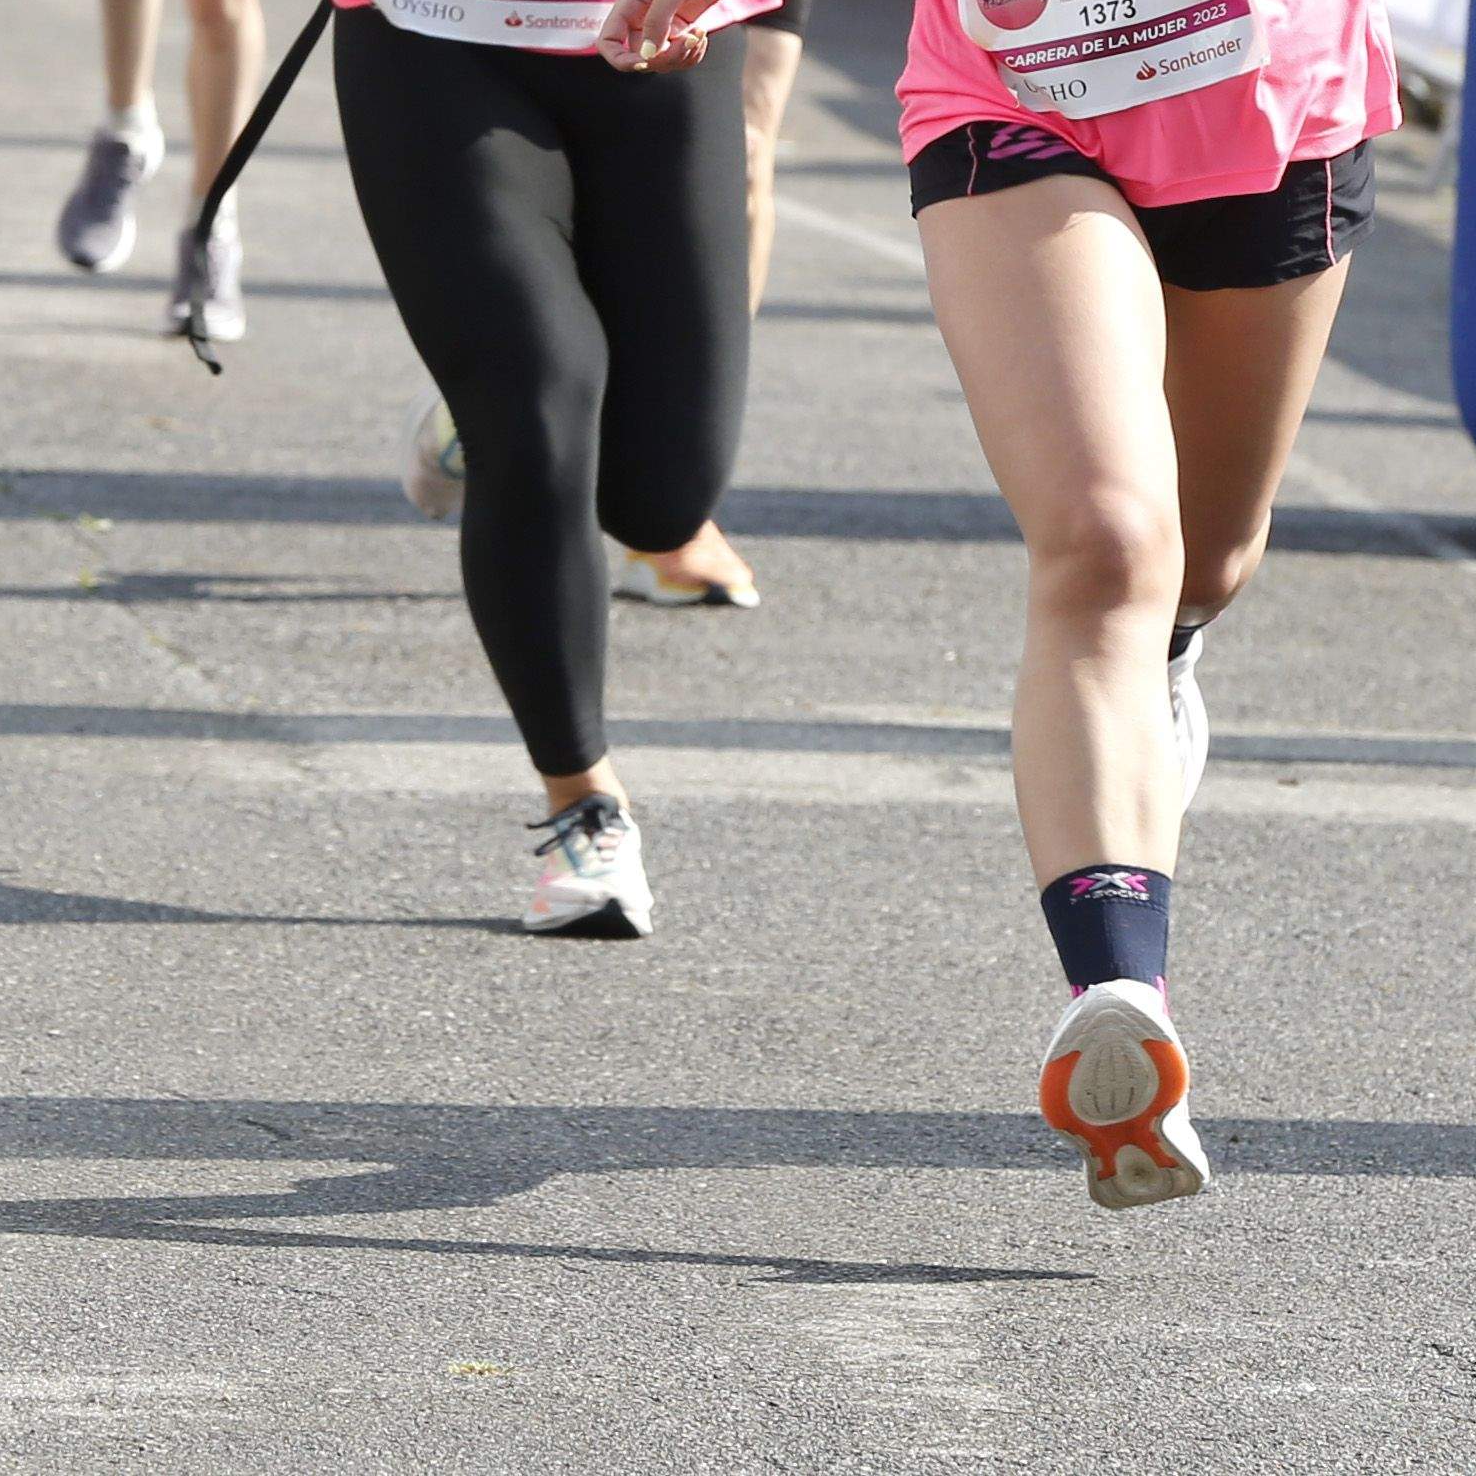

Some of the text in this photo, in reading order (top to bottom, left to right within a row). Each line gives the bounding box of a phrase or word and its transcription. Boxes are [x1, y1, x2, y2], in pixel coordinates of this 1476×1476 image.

[1004, 3, 1228, 69] CARRERA DE LA MUJER 2023
[1159, 35, 1242, 76] Santander
